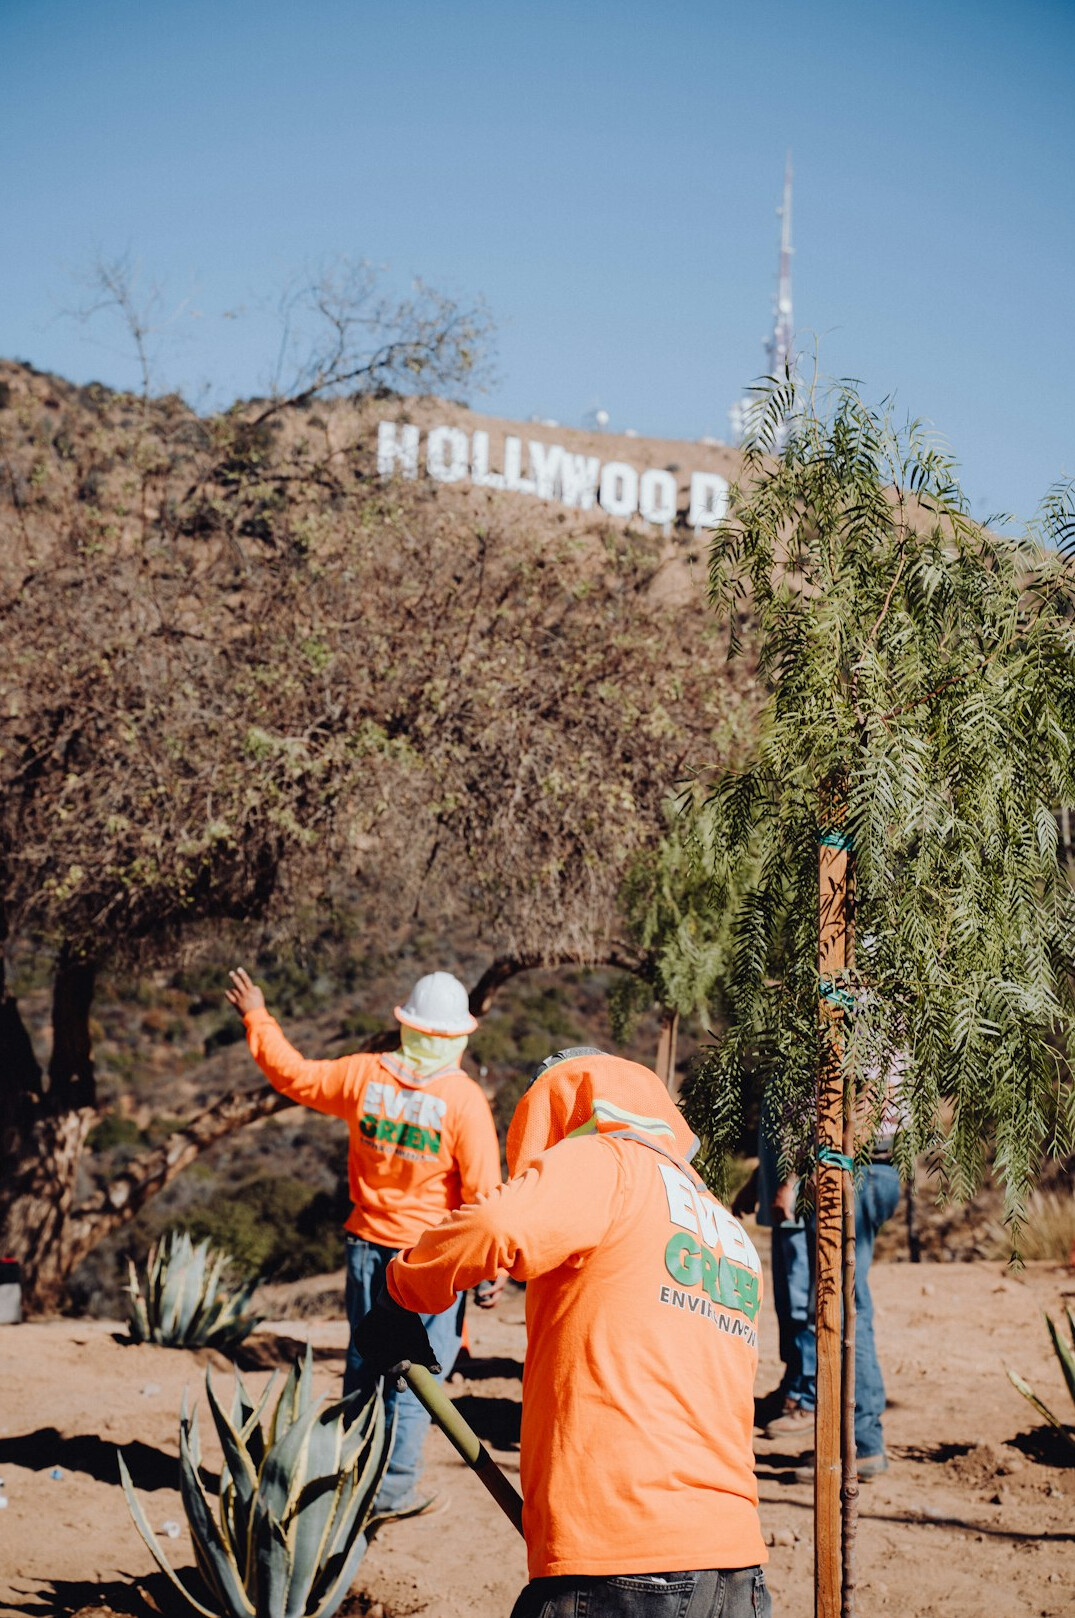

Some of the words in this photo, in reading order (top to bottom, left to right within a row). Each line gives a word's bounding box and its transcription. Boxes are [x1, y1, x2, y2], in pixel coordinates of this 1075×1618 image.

[376, 420, 730, 529] HOLLYWOOD
[363, 1081, 447, 1131] EVER
[359, 1114, 441, 1154] GREEN
